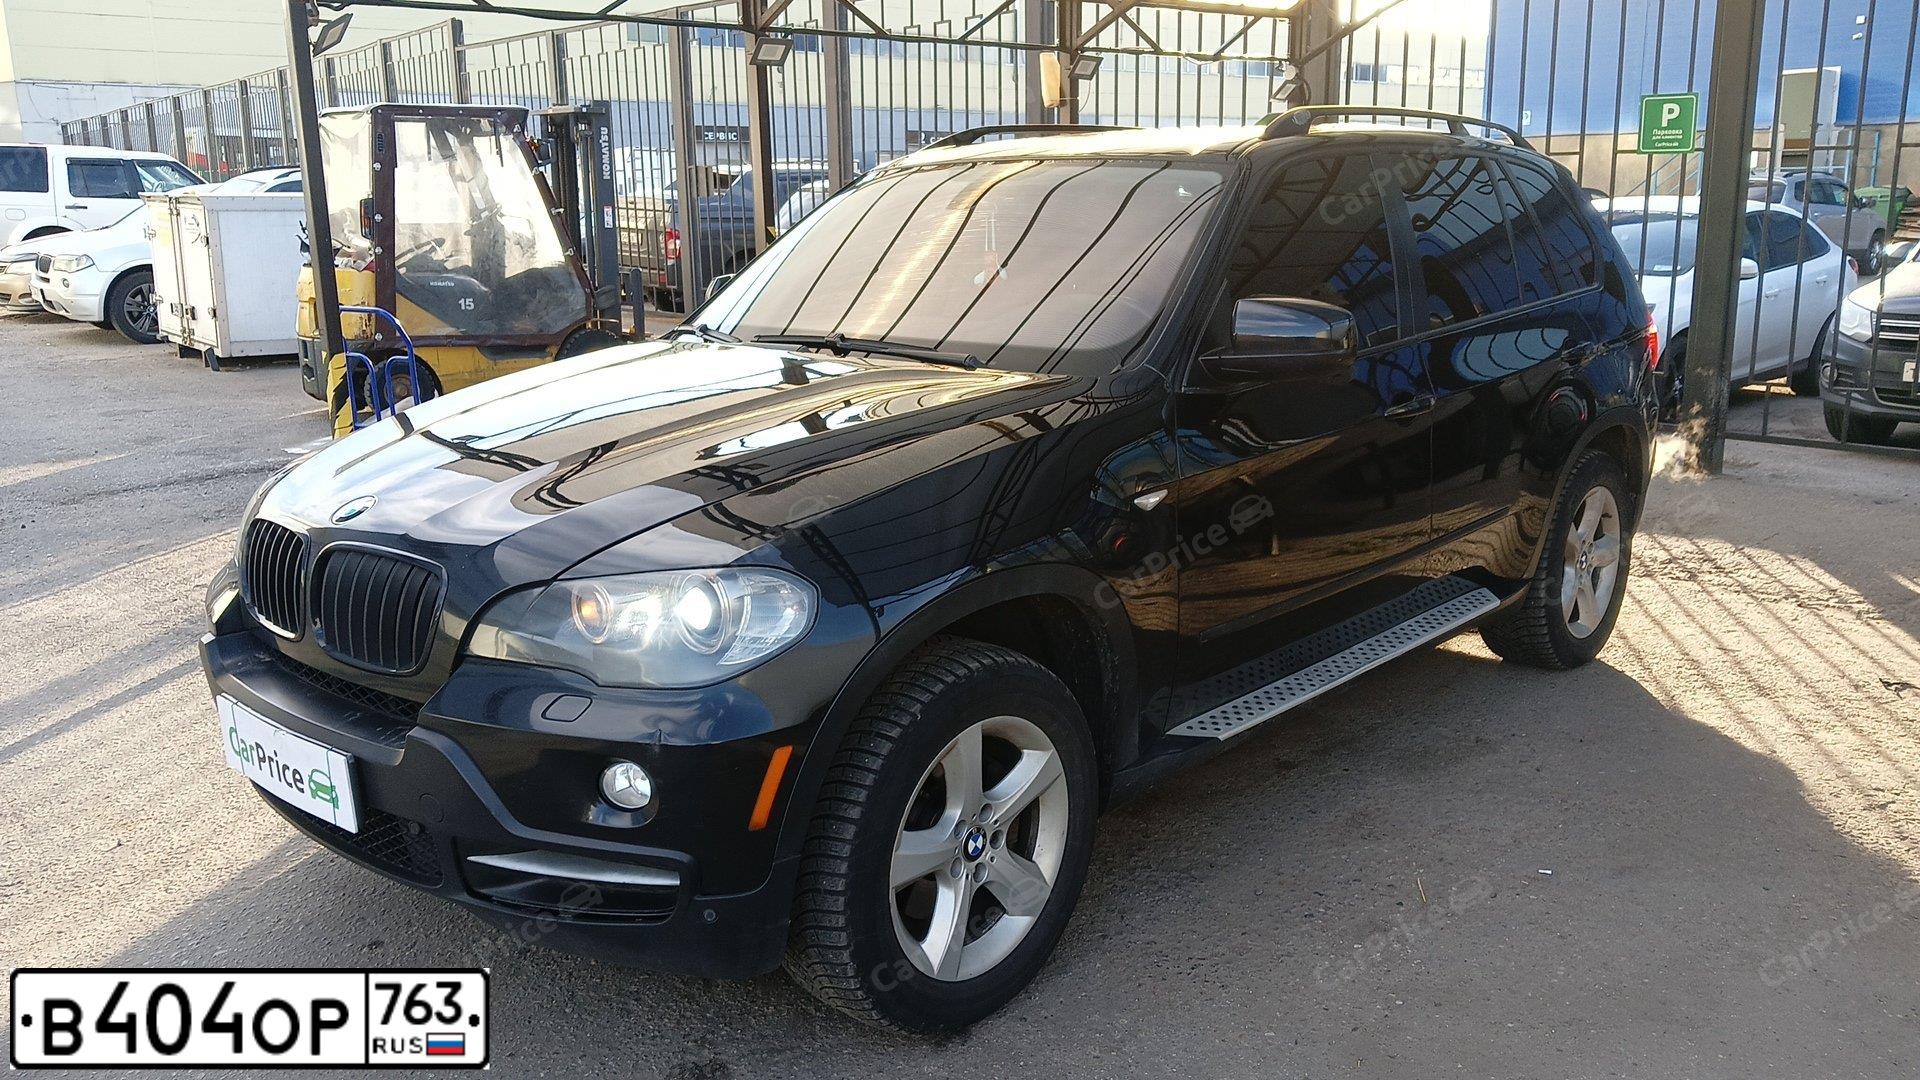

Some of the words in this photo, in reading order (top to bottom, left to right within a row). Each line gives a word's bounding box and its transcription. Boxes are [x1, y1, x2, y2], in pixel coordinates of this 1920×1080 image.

[1662, 103, 1680, 127] P
[1652, 129, 1683, 137] Парковка
[600, 126, 611, 180] KOMATSU
[458, 298, 475, 310] 15
[229, 726, 305, 794] CarPrice
